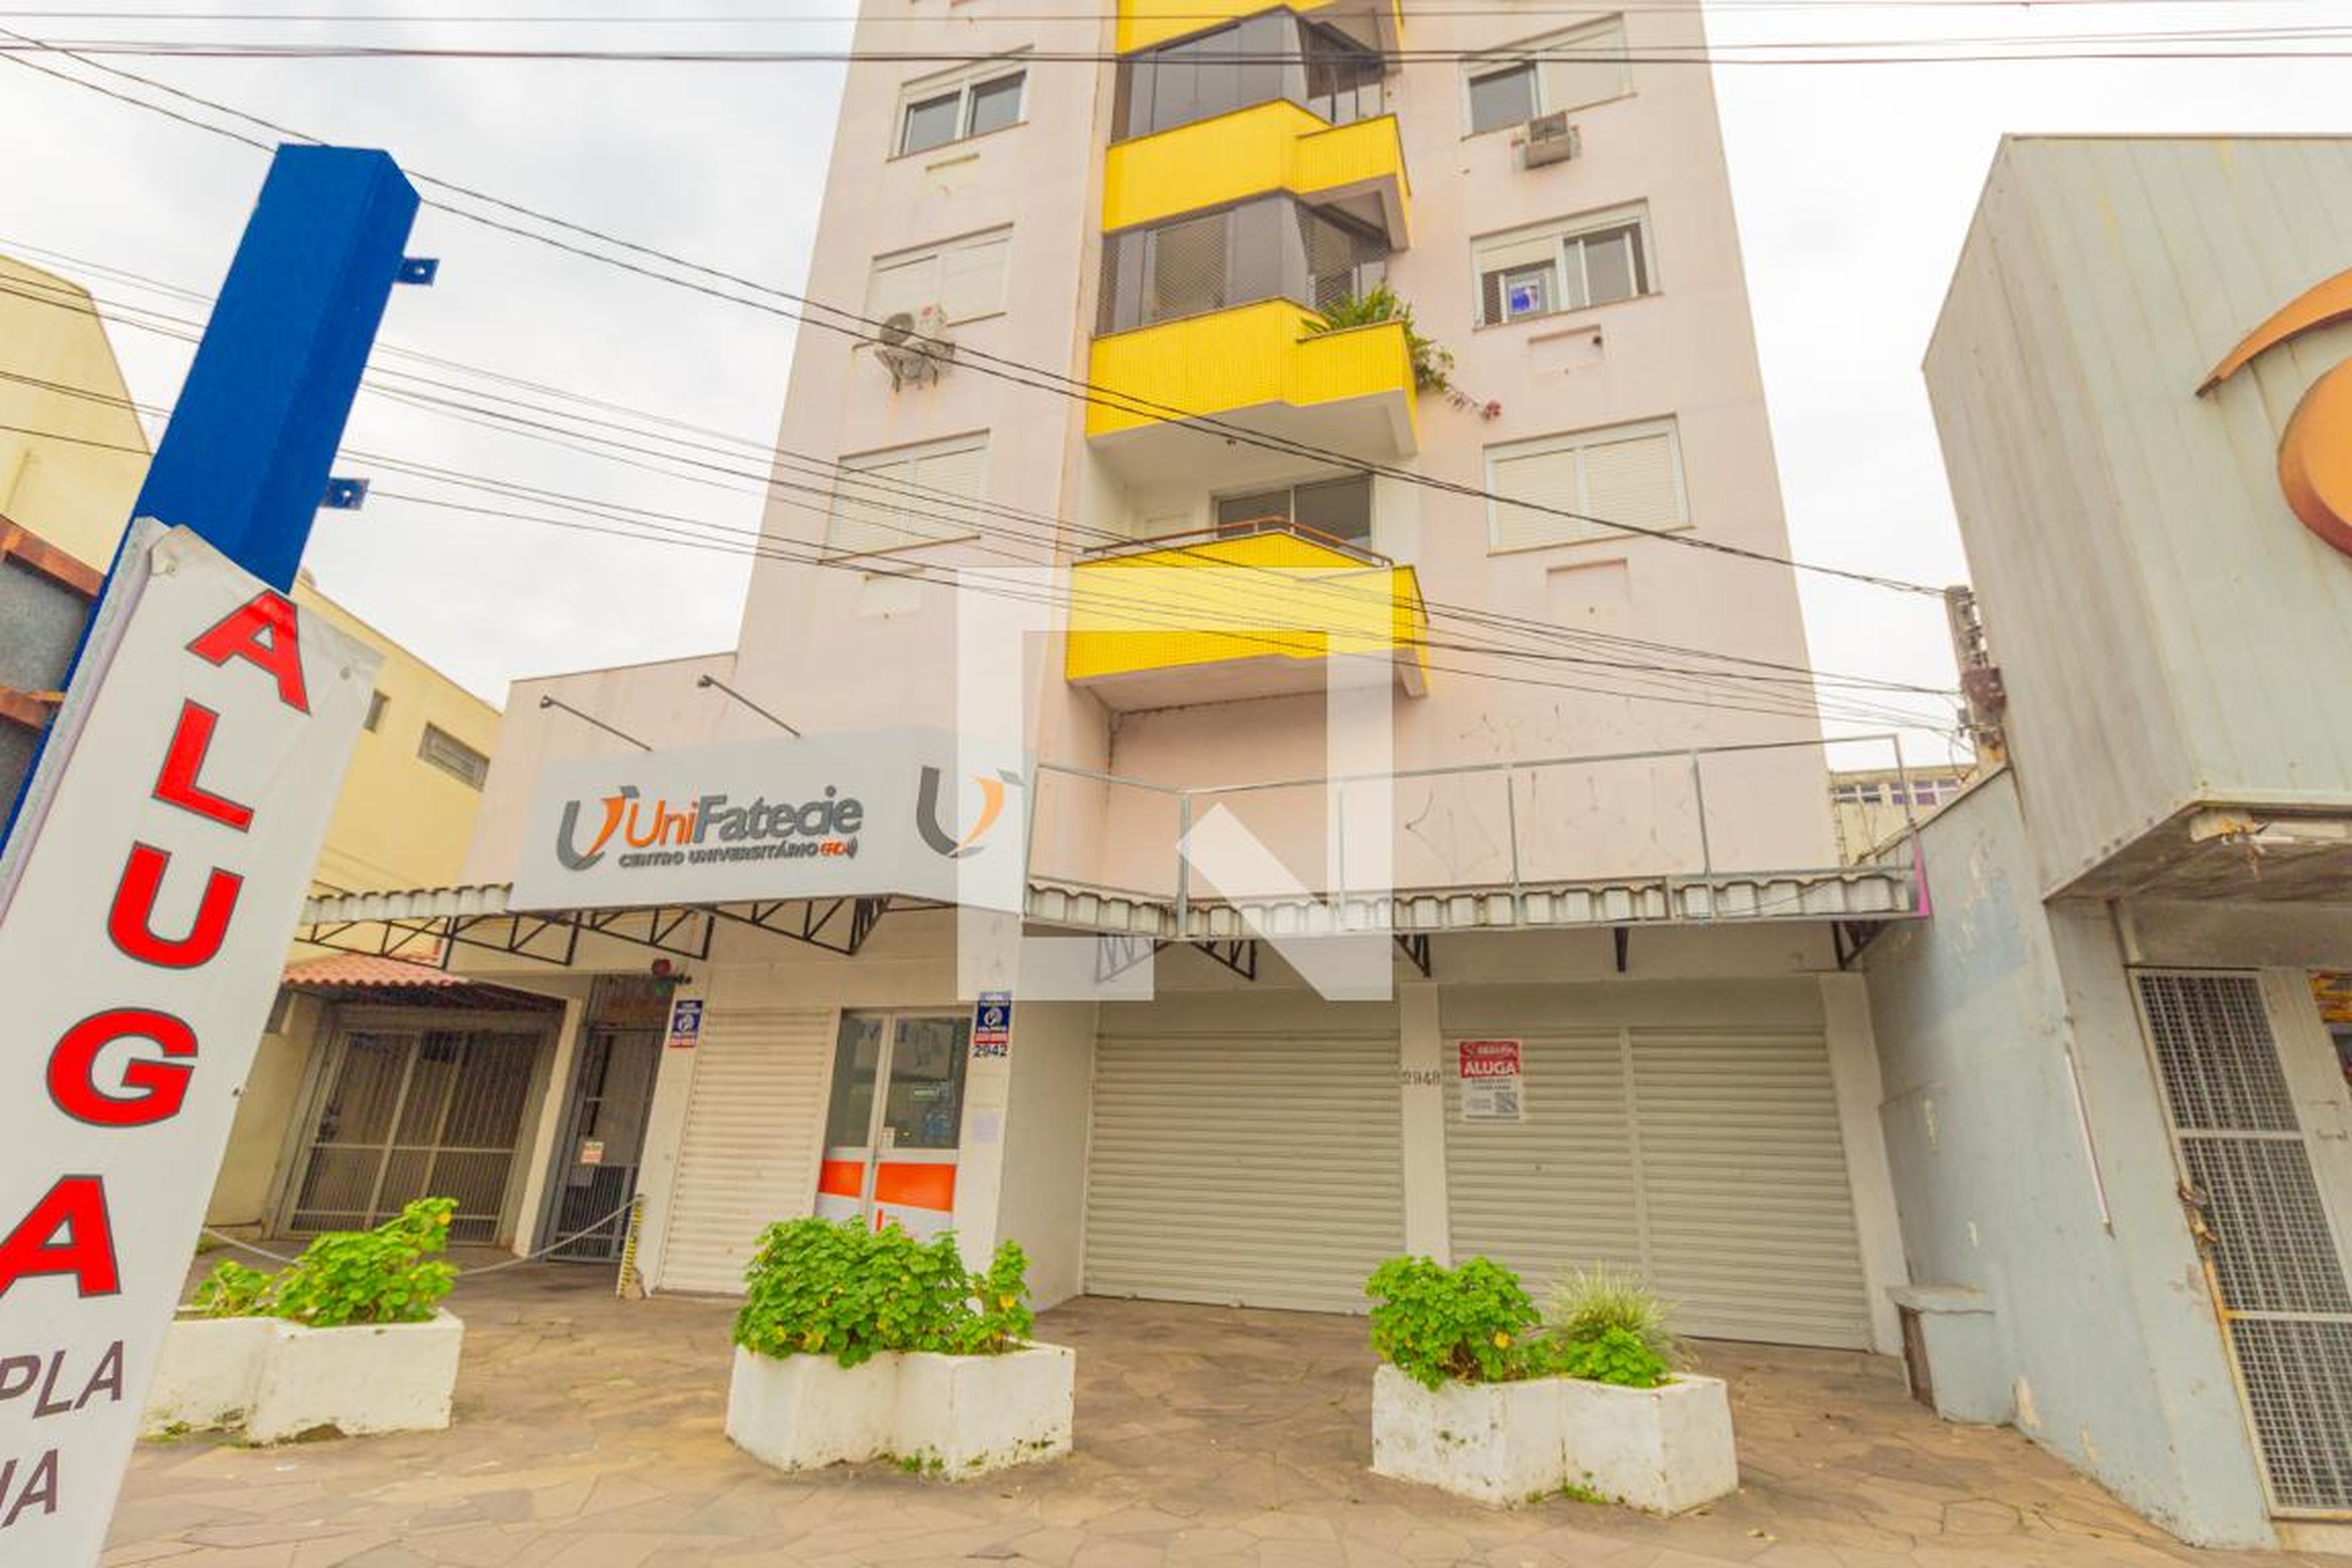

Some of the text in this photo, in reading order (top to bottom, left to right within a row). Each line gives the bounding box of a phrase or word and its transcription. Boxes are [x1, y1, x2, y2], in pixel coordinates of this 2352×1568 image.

[624, 785, 864, 848] UniFatecie
[619, 851, 685, 869] CENTRO
[687, 841, 818, 865] UNIVERSITÁRIO
[0, 589, 311, 1310] ALUGA
[1464, 1061, 1517, 1076] ALUGA
